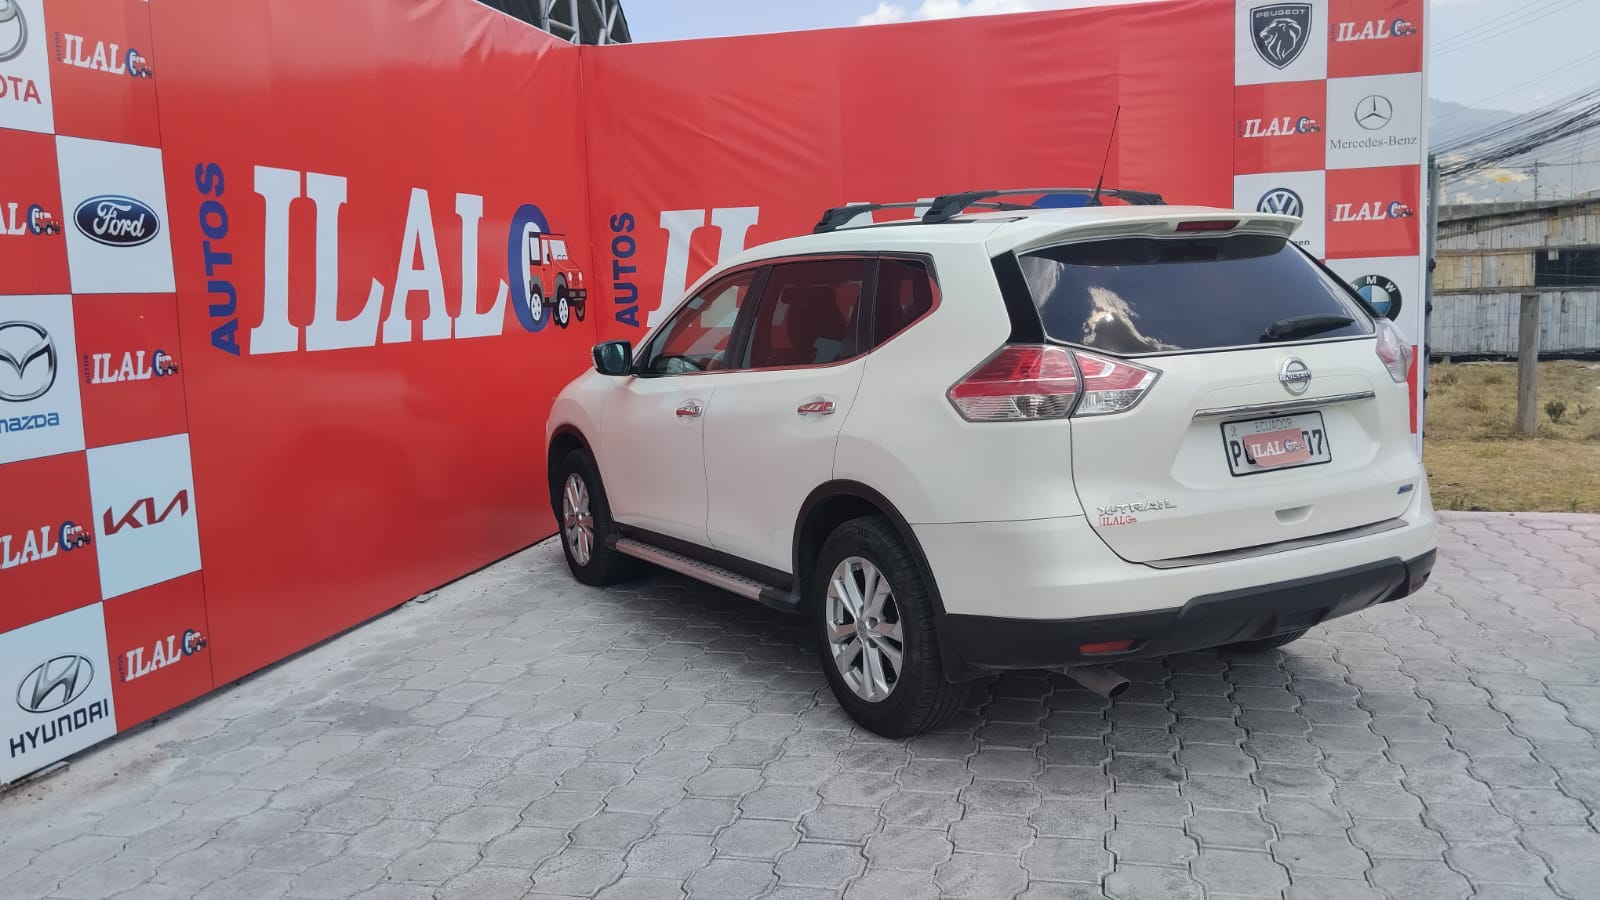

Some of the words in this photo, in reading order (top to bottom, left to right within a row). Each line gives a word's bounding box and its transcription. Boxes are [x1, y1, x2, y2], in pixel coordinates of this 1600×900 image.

[1256, 9, 1305, 18] PEUGEOT
[1330, 136, 1418, 150] Mercedes-Benz
[93, 201, 147, 238] Ford
[194, 161, 241, 357] AUTOS
[610, 211, 640, 328] AUTOS
[1254, 417, 1294, 433] ECUADOR
[103, 488, 189, 537] KIA
[1097, 499, 1177, 516] X-TRAIL
[9, 698, 110, 758] HYUNDAI
